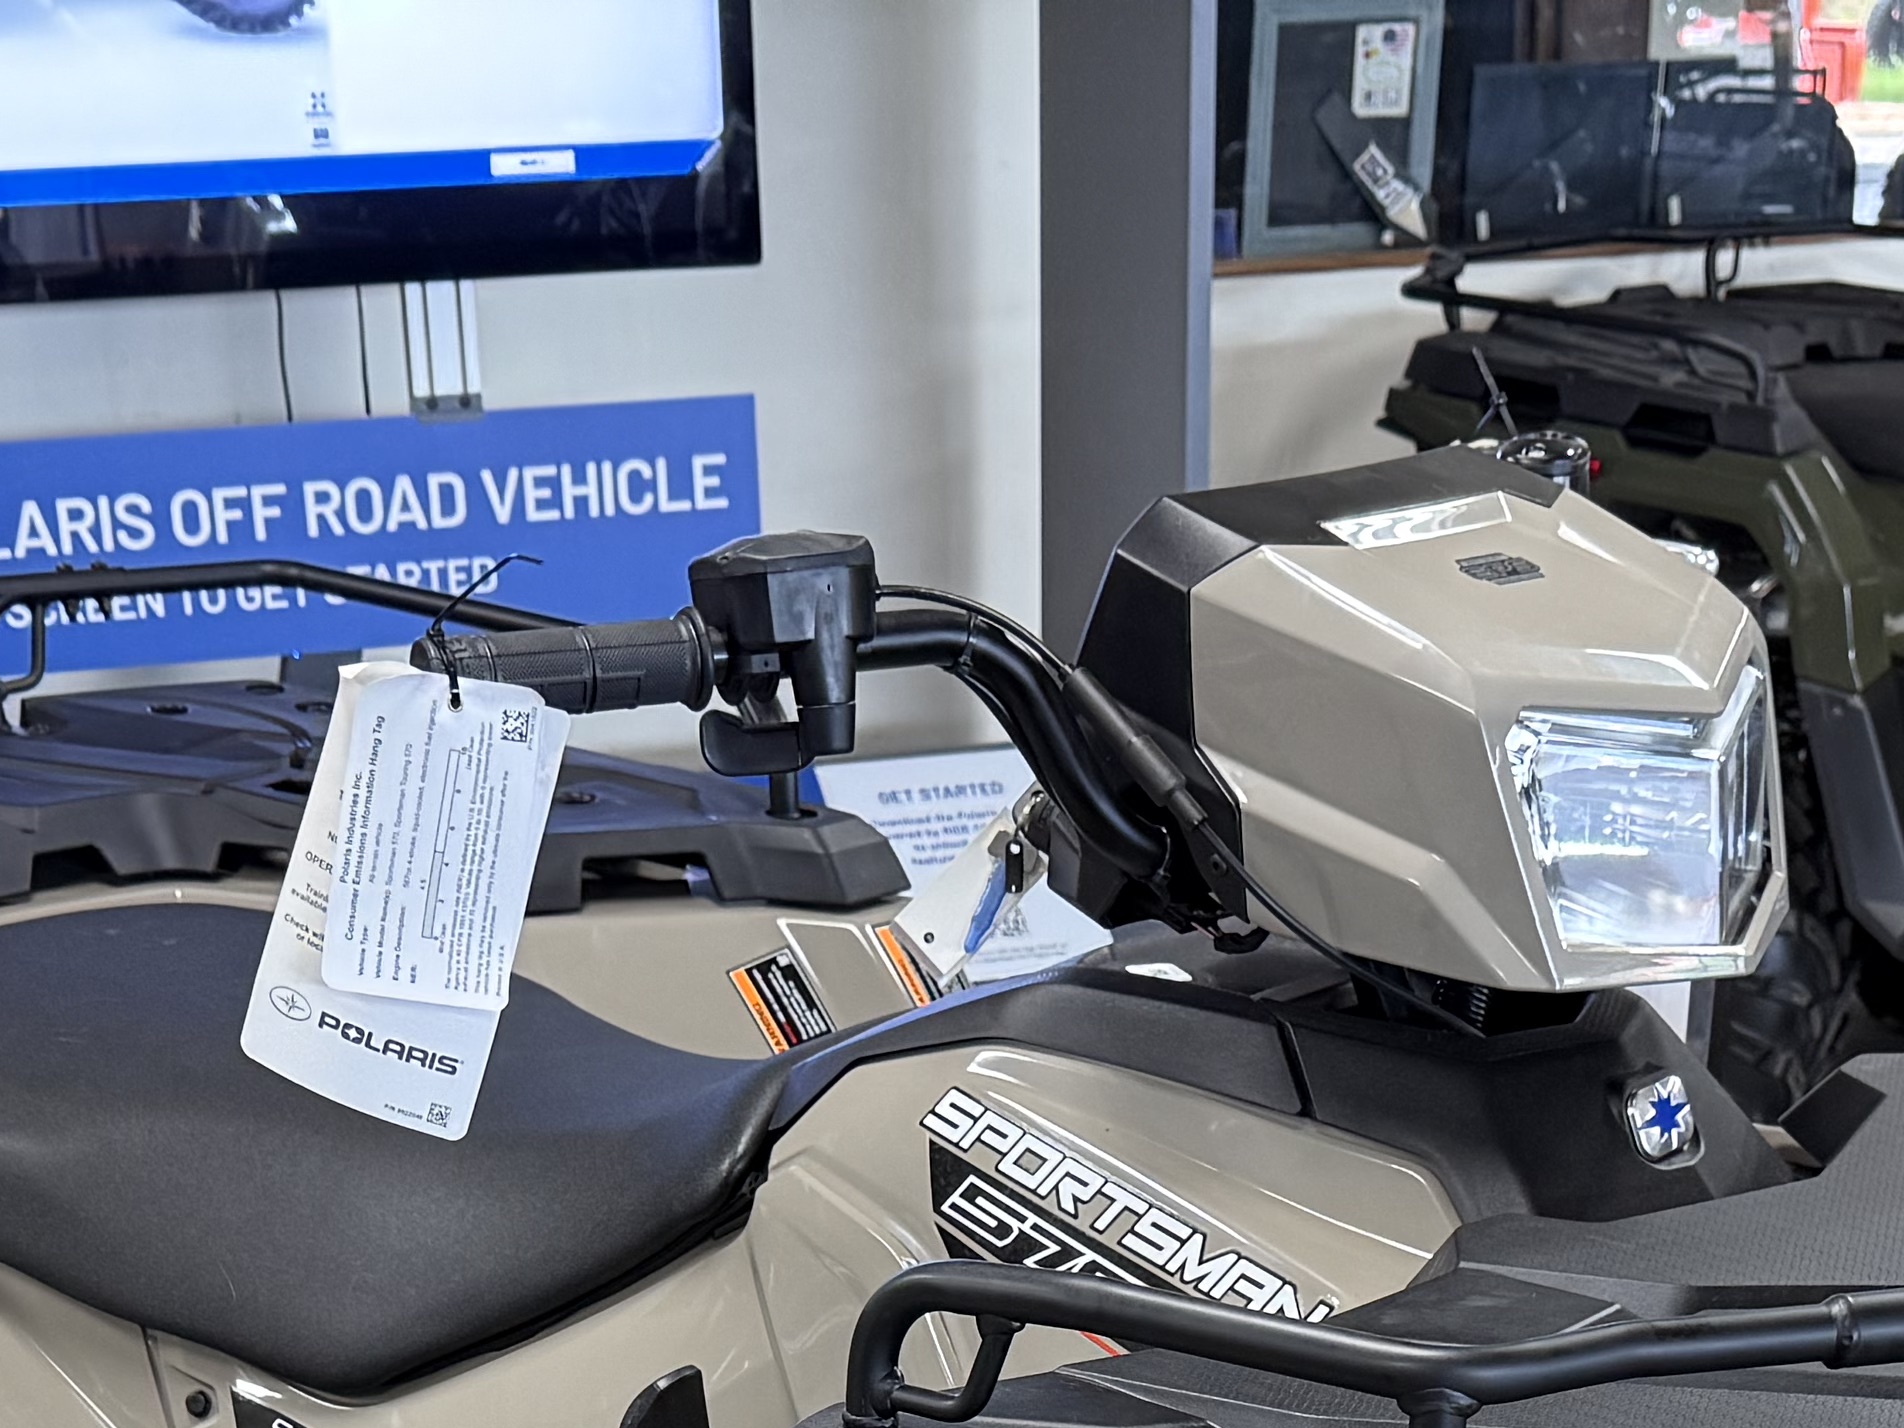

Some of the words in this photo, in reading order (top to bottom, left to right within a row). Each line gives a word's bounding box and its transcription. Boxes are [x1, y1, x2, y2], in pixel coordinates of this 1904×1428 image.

[171, 480, 289, 547] OFF
[306, 469, 470, 537] ROAD
[483, 453, 729, 521] VEHICLE
[371, 715, 385, 734] Tag
[367, 737, 382, 766] Hang
[351, 770, 362, 790] Inc.
[359, 768, 376, 829] Information
[877, 788, 913, 806] GET
[919, 780, 1004, 802] STARTED
[343, 792, 359, 845] Industries
[338, 847, 352, 883] Polaris
[351, 831, 367, 885] Emissions
[284, 913, 309, 933] Check
[344, 887, 359, 941] Consumer
[317, 1009, 461, 1076] POLARIS
[919, 1086, 1338, 1324] SPORTSMAN
